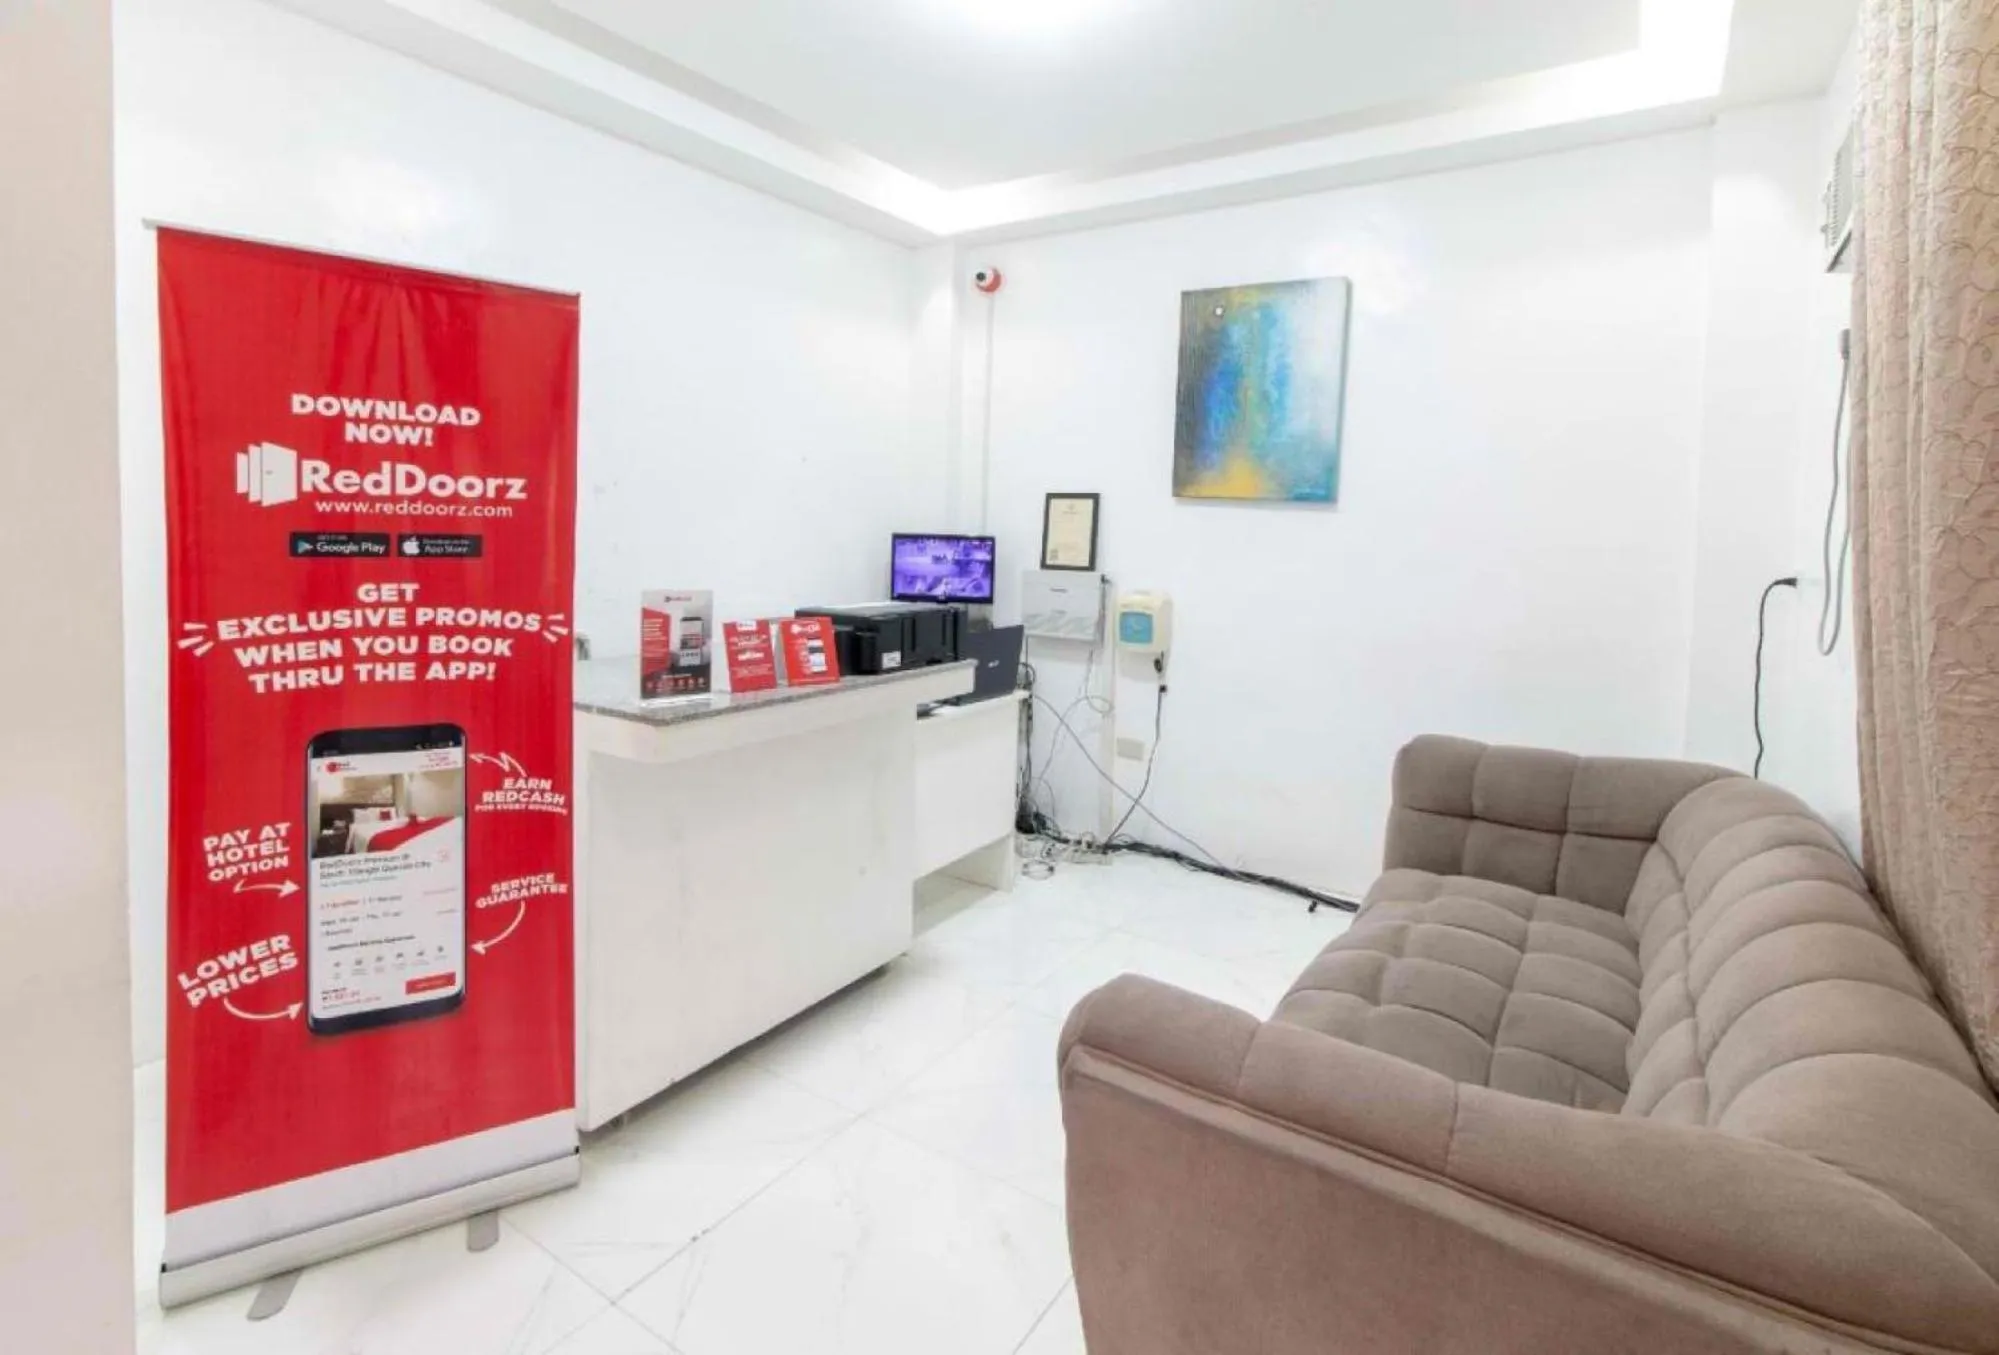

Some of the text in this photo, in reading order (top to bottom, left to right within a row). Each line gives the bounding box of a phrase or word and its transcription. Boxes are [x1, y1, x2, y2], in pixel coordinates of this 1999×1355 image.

[292, 394, 480, 426] DOWNLOAD
[345, 422, 434, 447] NOW!
[301, 460, 527, 500] RedDoorz
[315, 499, 513, 519] www.reddoorz.com
[316, 541, 386, 555] Google Play
[357, 583, 420, 603] GET
[218, 608, 541, 641] EXCLUSIVE PROMOS
[234, 635, 513, 669] WHEN YOU BOOK
[249, 661, 496, 694] THRU THE APP!
[482, 789, 566, 806] REDCASH
[503, 777, 553, 791] EARN
[204, 823, 292, 853] PAY AT
[206, 839, 290, 868] HOTEL
[208, 855, 289, 882] OPTION
[475, 883, 568, 908] GUARANTEE
[491, 873, 555, 894] SERVICE
[178, 935, 291, 990] LOWER
[187, 952, 298, 1008] PRICES
